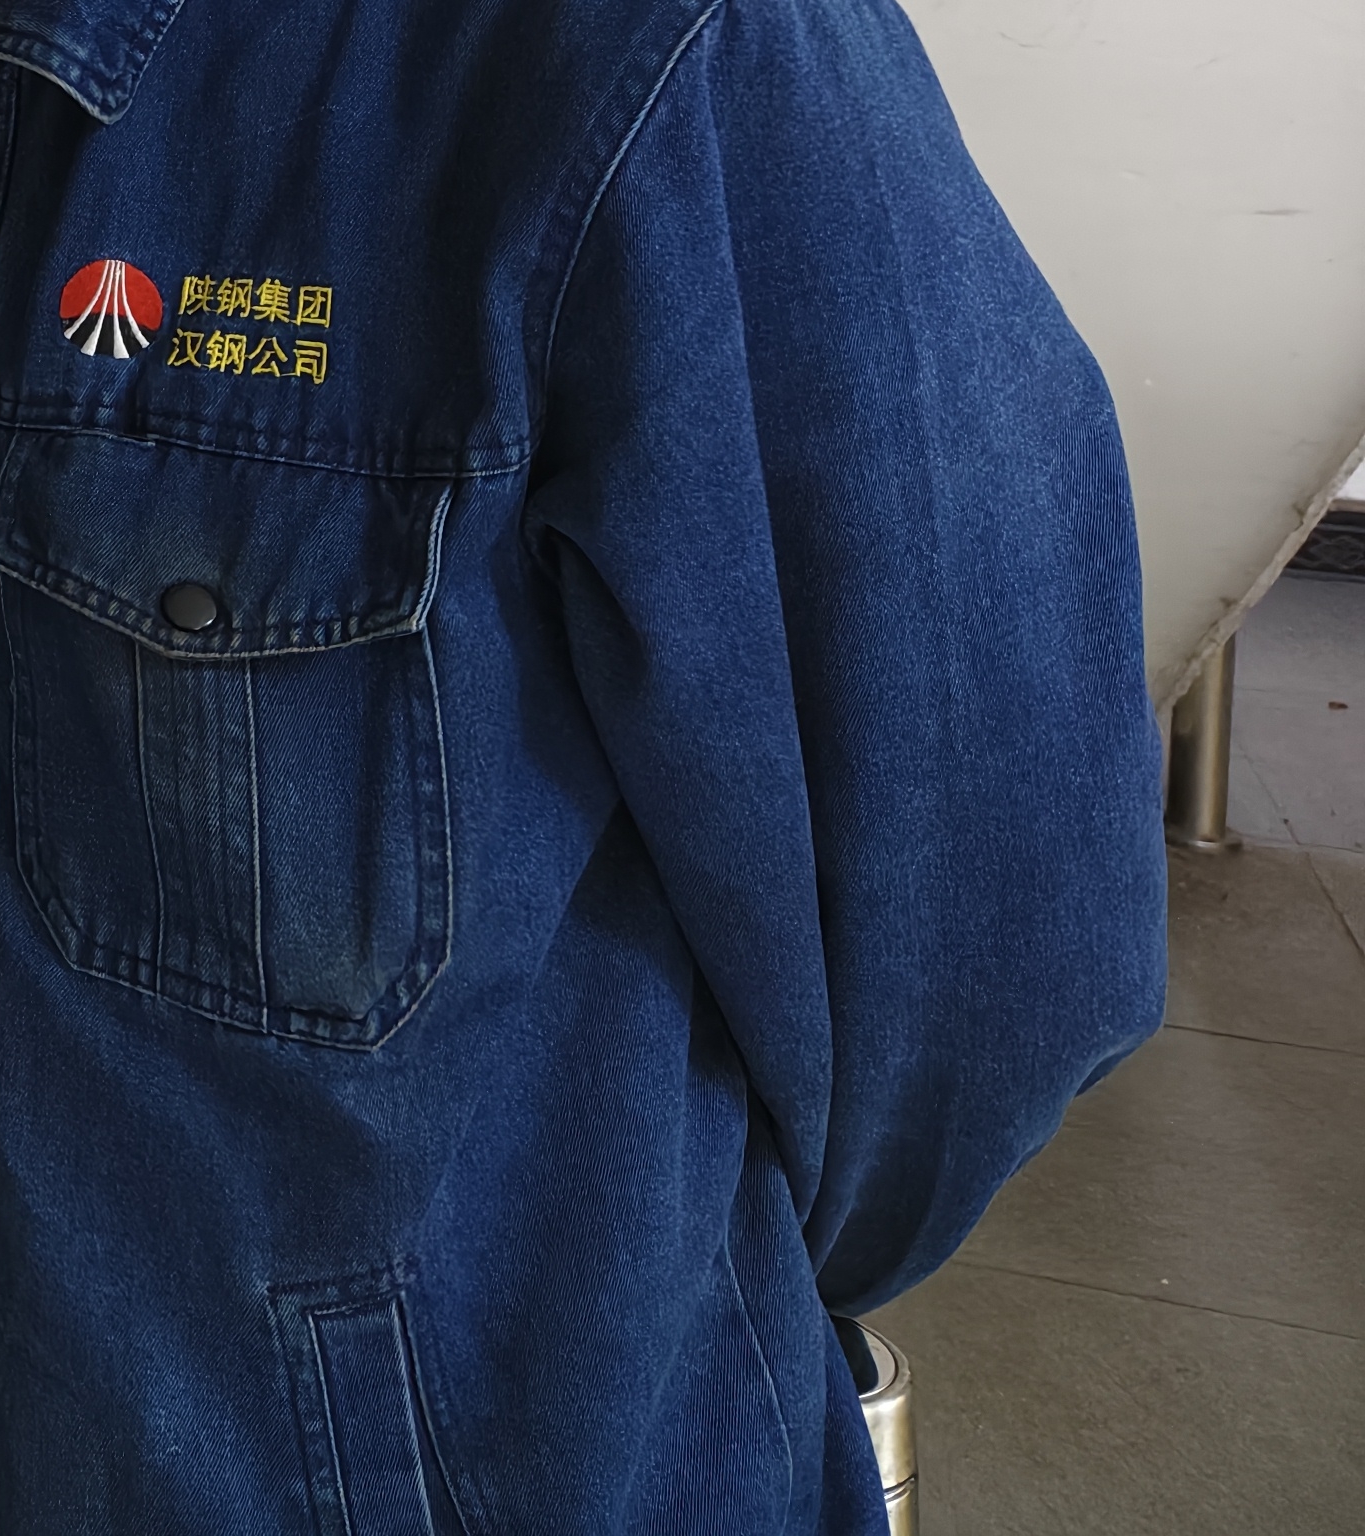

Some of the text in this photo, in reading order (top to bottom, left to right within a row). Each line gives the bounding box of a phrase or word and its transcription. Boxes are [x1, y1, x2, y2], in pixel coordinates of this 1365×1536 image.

[178, 274, 332, 328] 陕钢集团
[167, 328, 327, 384] 汉钢公司
